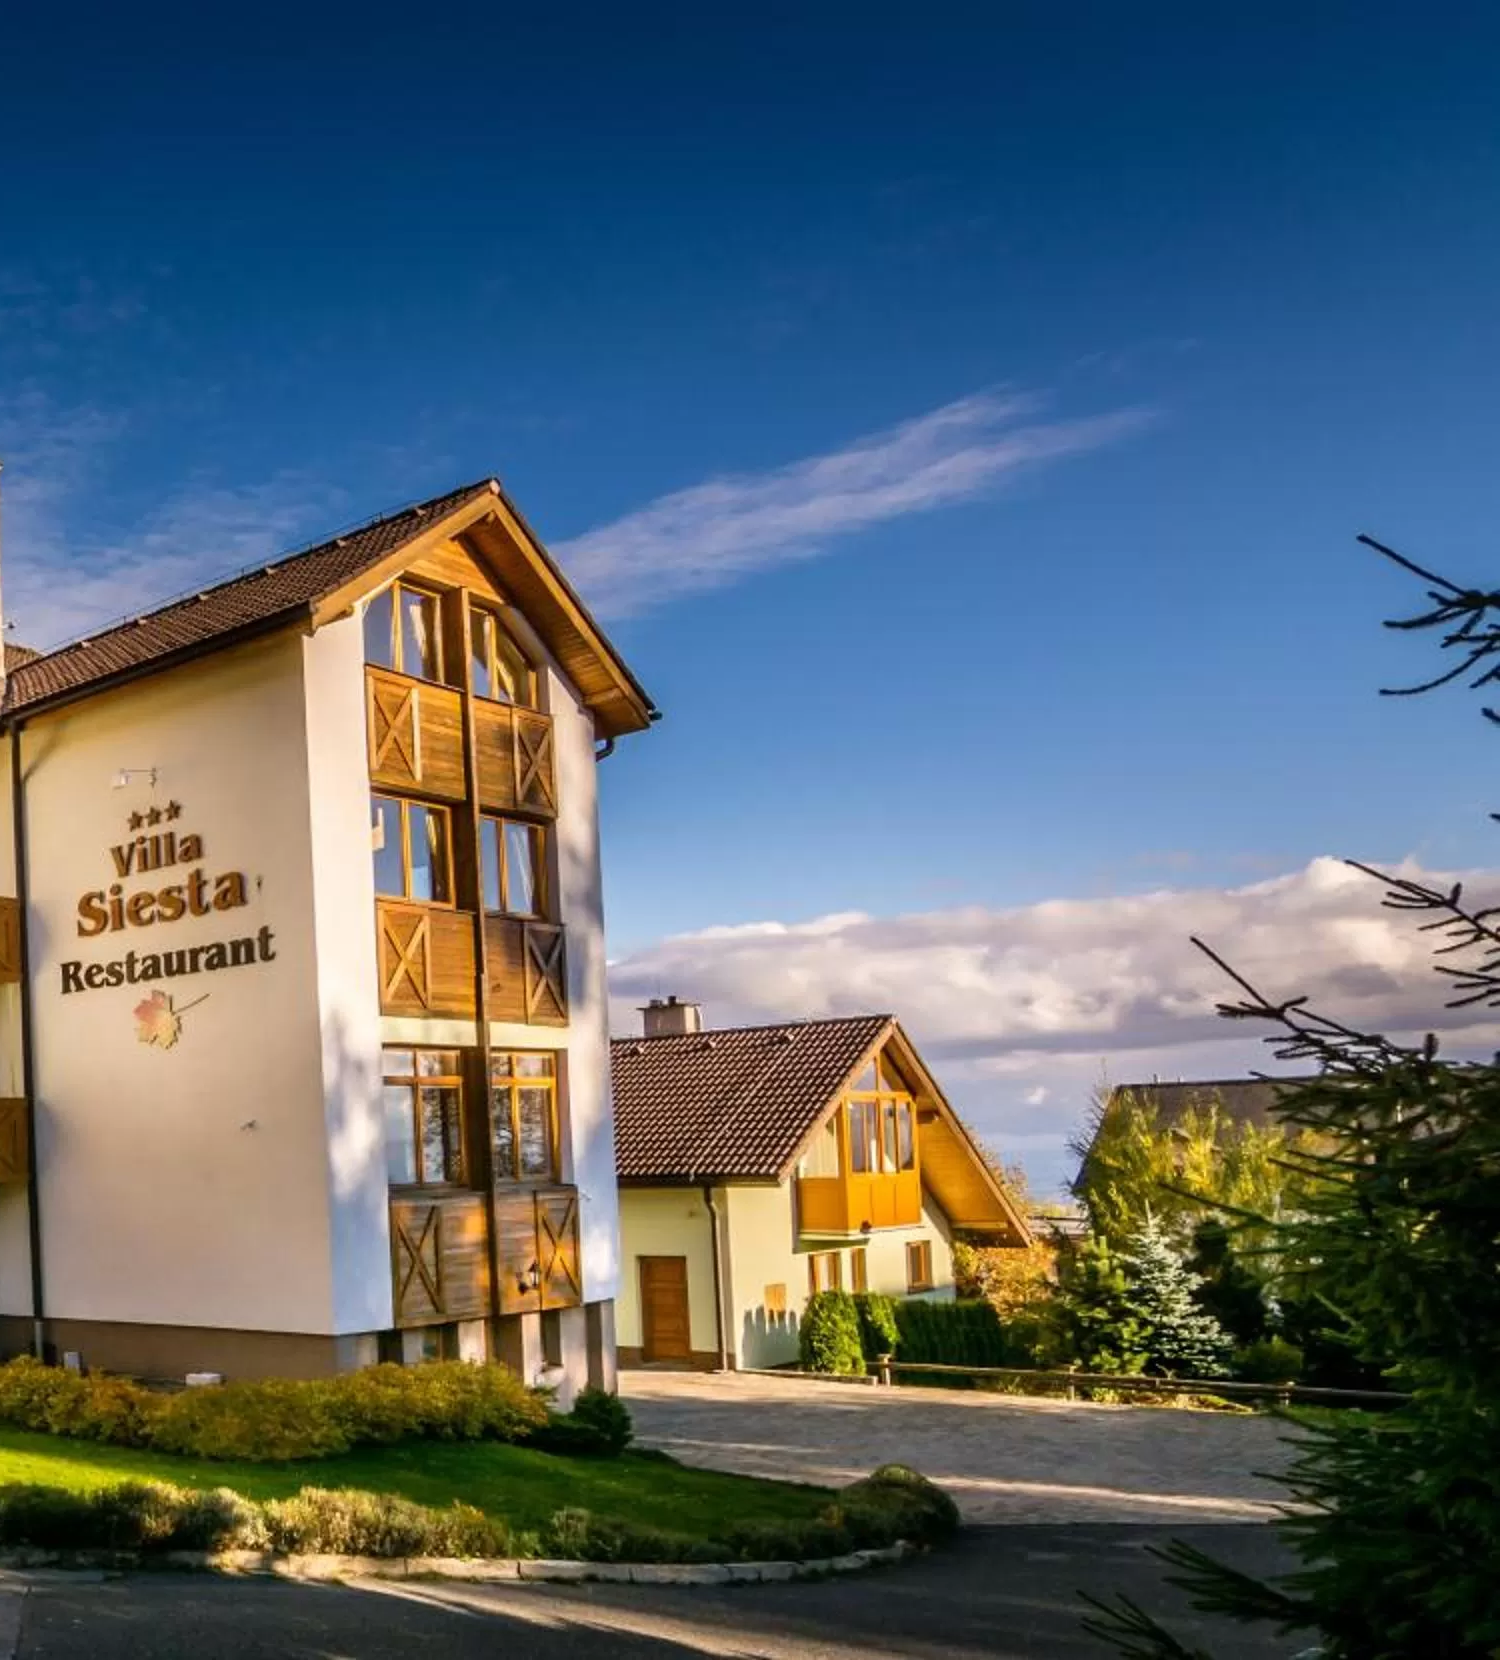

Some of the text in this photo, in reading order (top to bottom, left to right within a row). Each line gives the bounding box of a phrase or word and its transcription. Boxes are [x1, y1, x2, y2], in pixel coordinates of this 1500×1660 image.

[111, 831, 203, 877] Villa
[77, 868, 248, 937] Siesta
[61, 926, 276, 994] Restaurant
